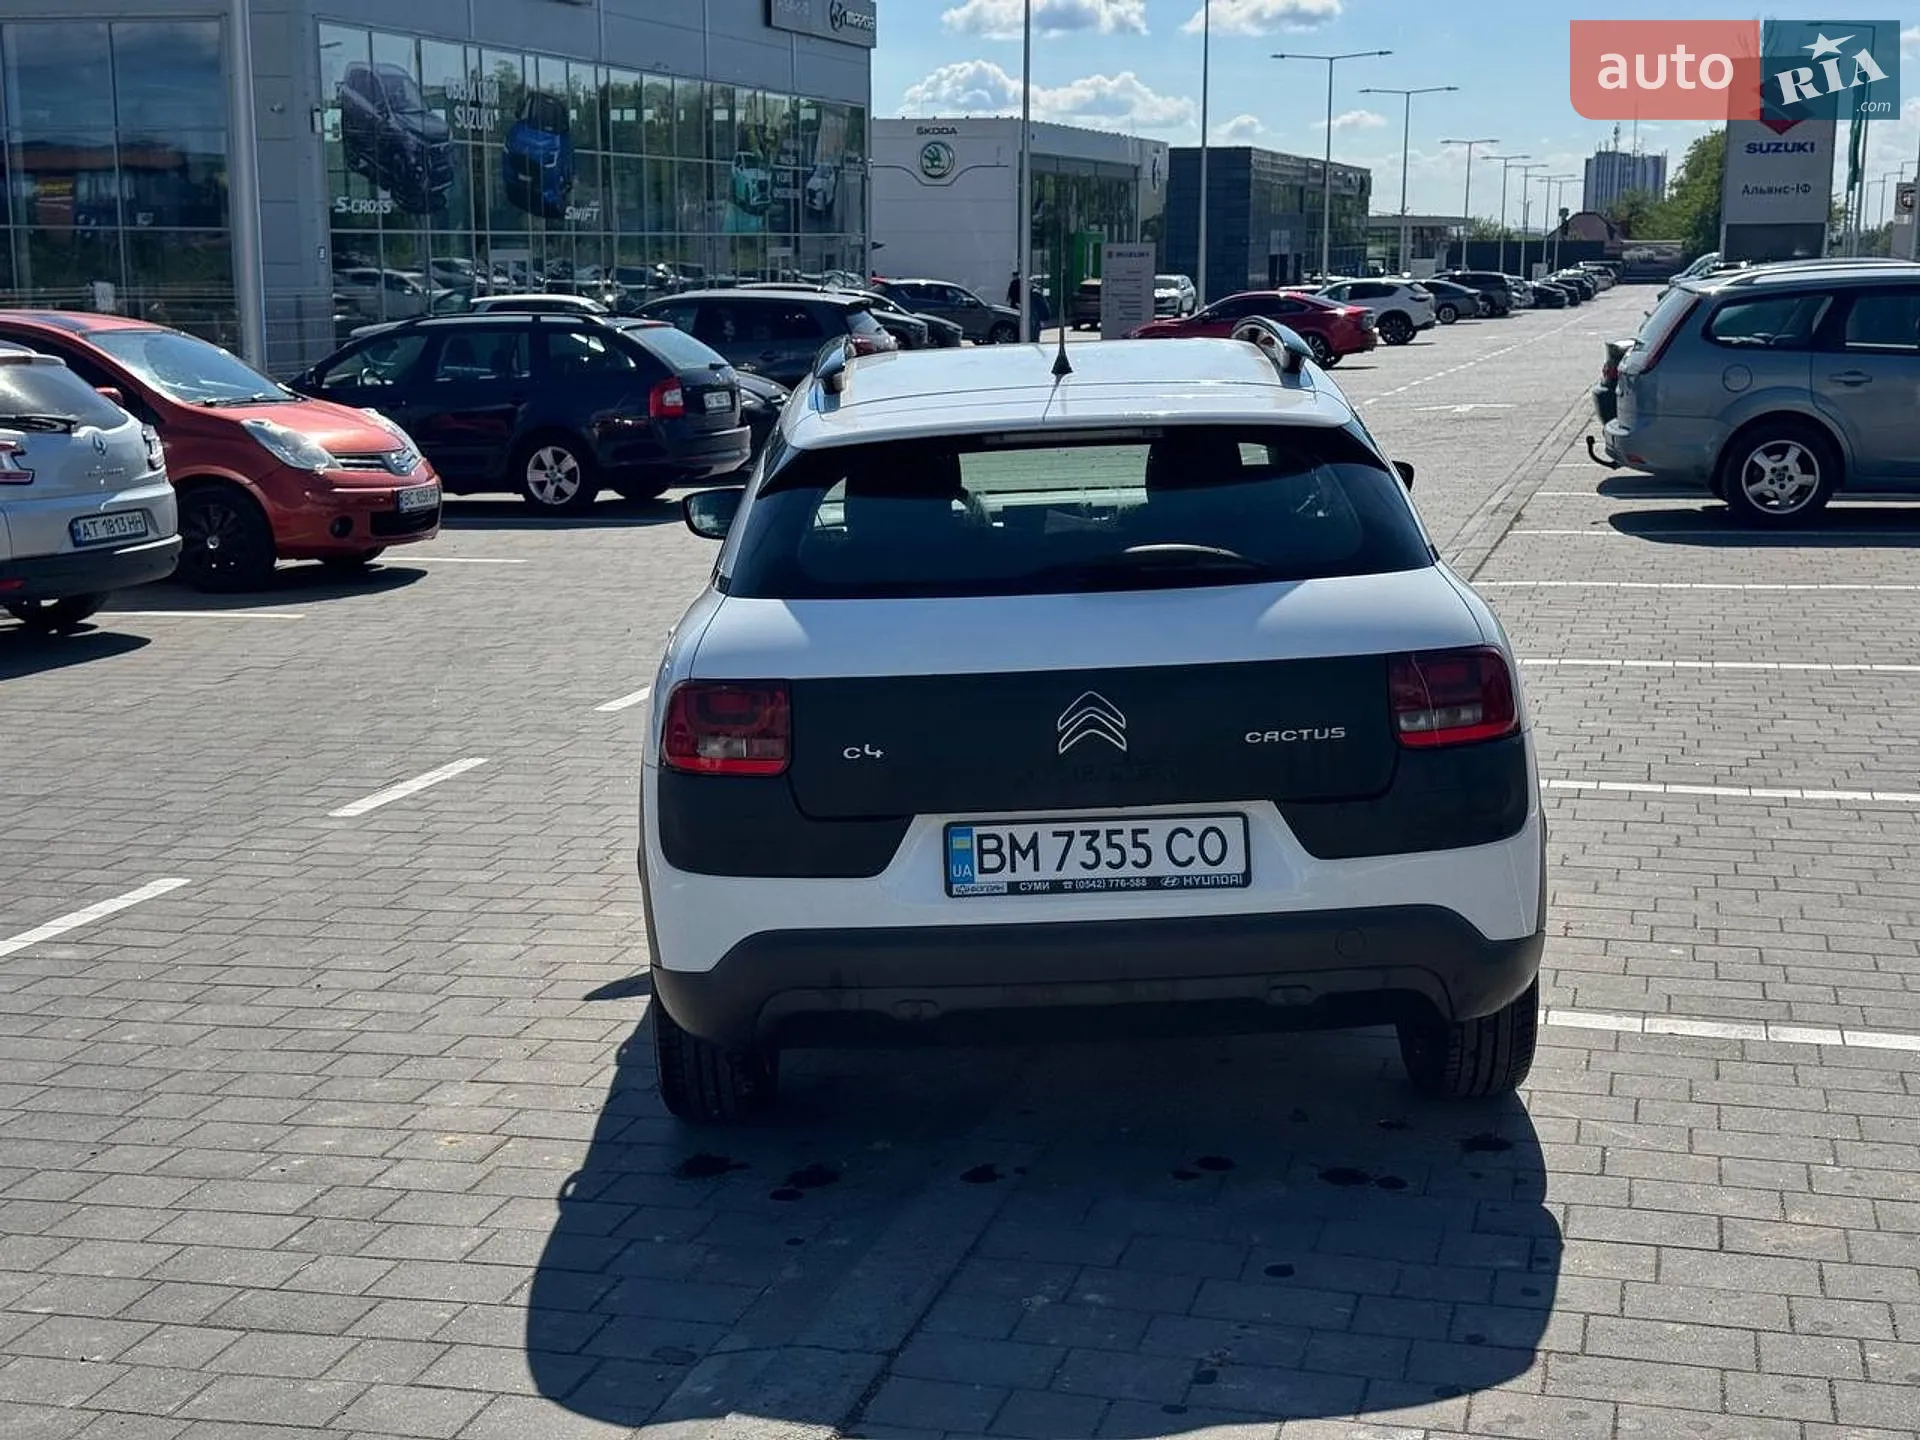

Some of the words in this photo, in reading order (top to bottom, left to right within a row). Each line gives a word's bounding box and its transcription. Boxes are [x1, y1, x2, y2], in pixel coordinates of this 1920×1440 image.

[1746, 141, 1815, 154] SUZUKI
[564, 206, 600, 222] SWIFT
[83, 521, 98, 537] AT
[1245, 727, 1346, 743] CACTUS
[976, 830, 1040, 875] BM
[1052, 828, 1152, 872] 7355
[1165, 826, 1228, 868] CO
[952, 864, 973, 878] UA
[1019, 881, 1050, 891] СУМИ
[1183, 874, 1243, 886] HYUNDAI
